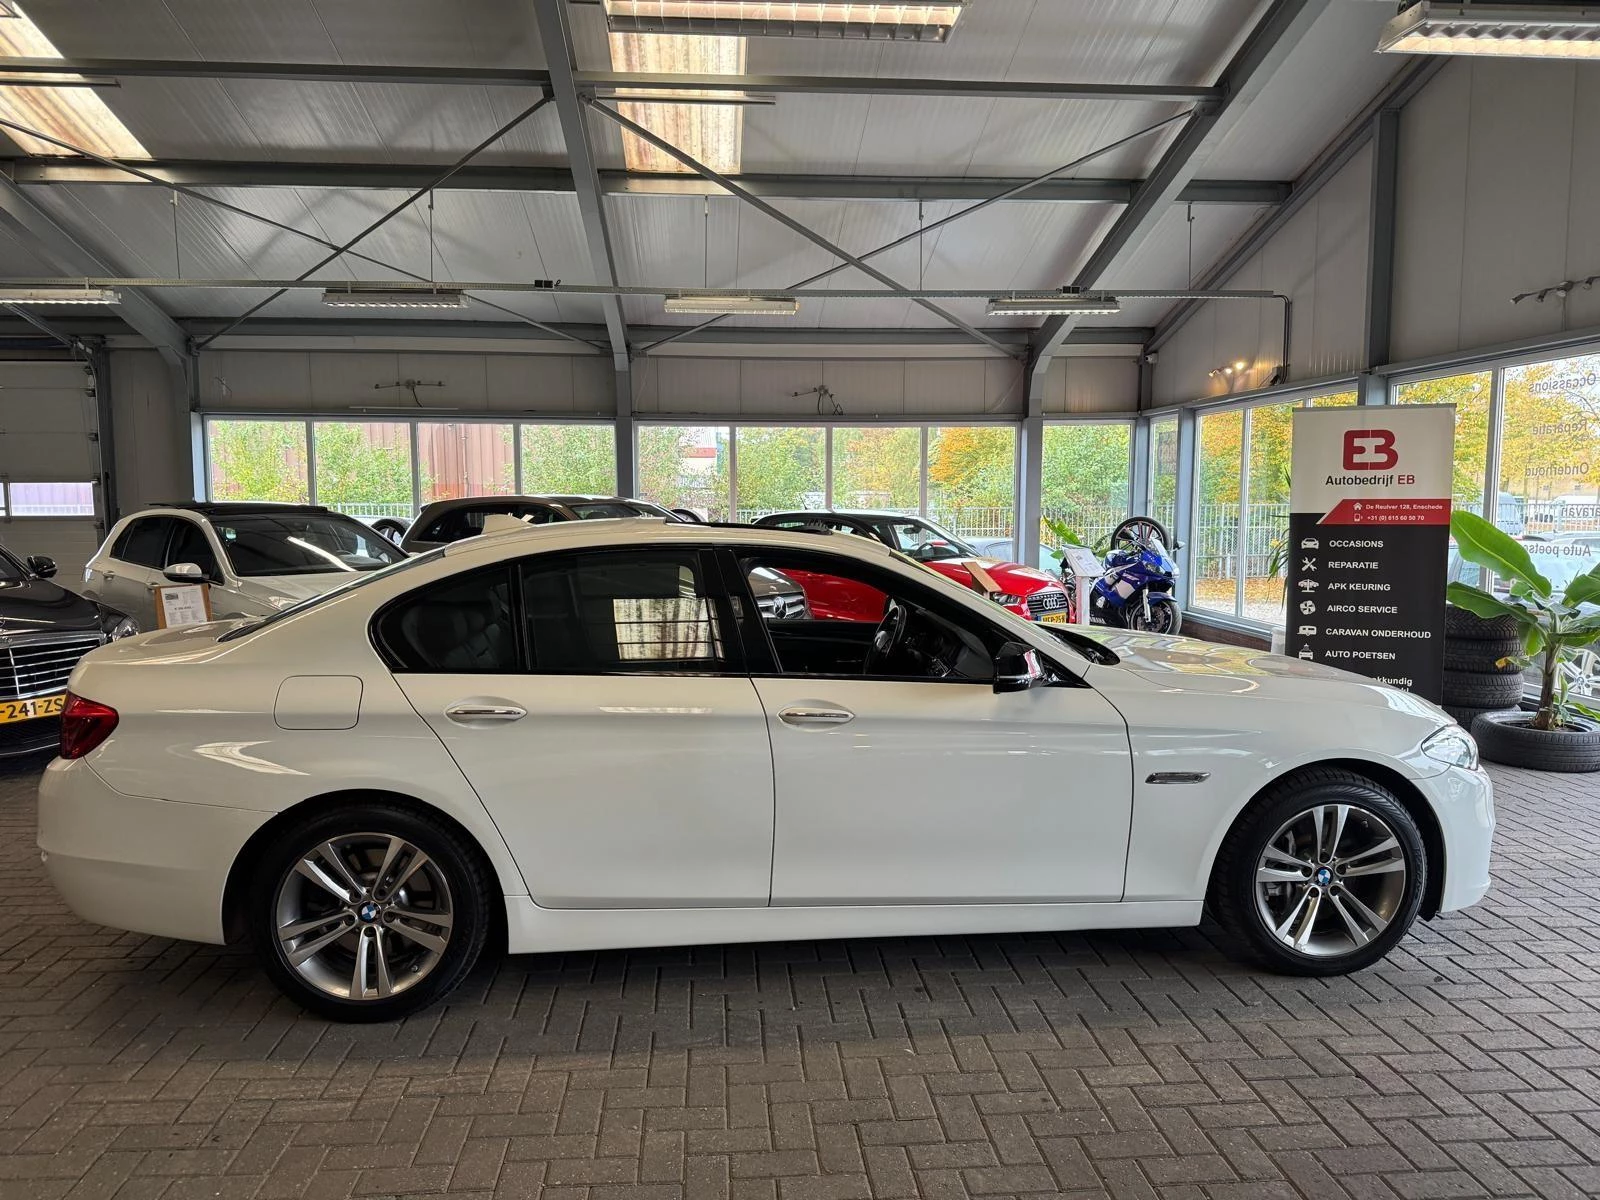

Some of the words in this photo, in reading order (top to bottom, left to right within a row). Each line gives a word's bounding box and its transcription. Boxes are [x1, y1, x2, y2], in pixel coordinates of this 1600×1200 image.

[1325, 475, 1394, 487] Autobedrijf
[1397, 475, 1415, 484] EB
[1329, 540, 1384, 548] OCCASIONS
[1328, 561, 1379, 569] REPARATIE
[1349, 583, 1391, 591] KEURING
[1327, 605, 1356, 613] AIRCO
[1358, 605, 1398, 613] SERVICE
[1325, 628, 1369, 636] CARAVAN
[1371, 629, 1431, 639] ONDERHOUD
[1325, 650, 1351, 658] AUTO
[1352, 651, 1396, 660] POETSEN
[1372, 676, 1413, 686] kkundig
